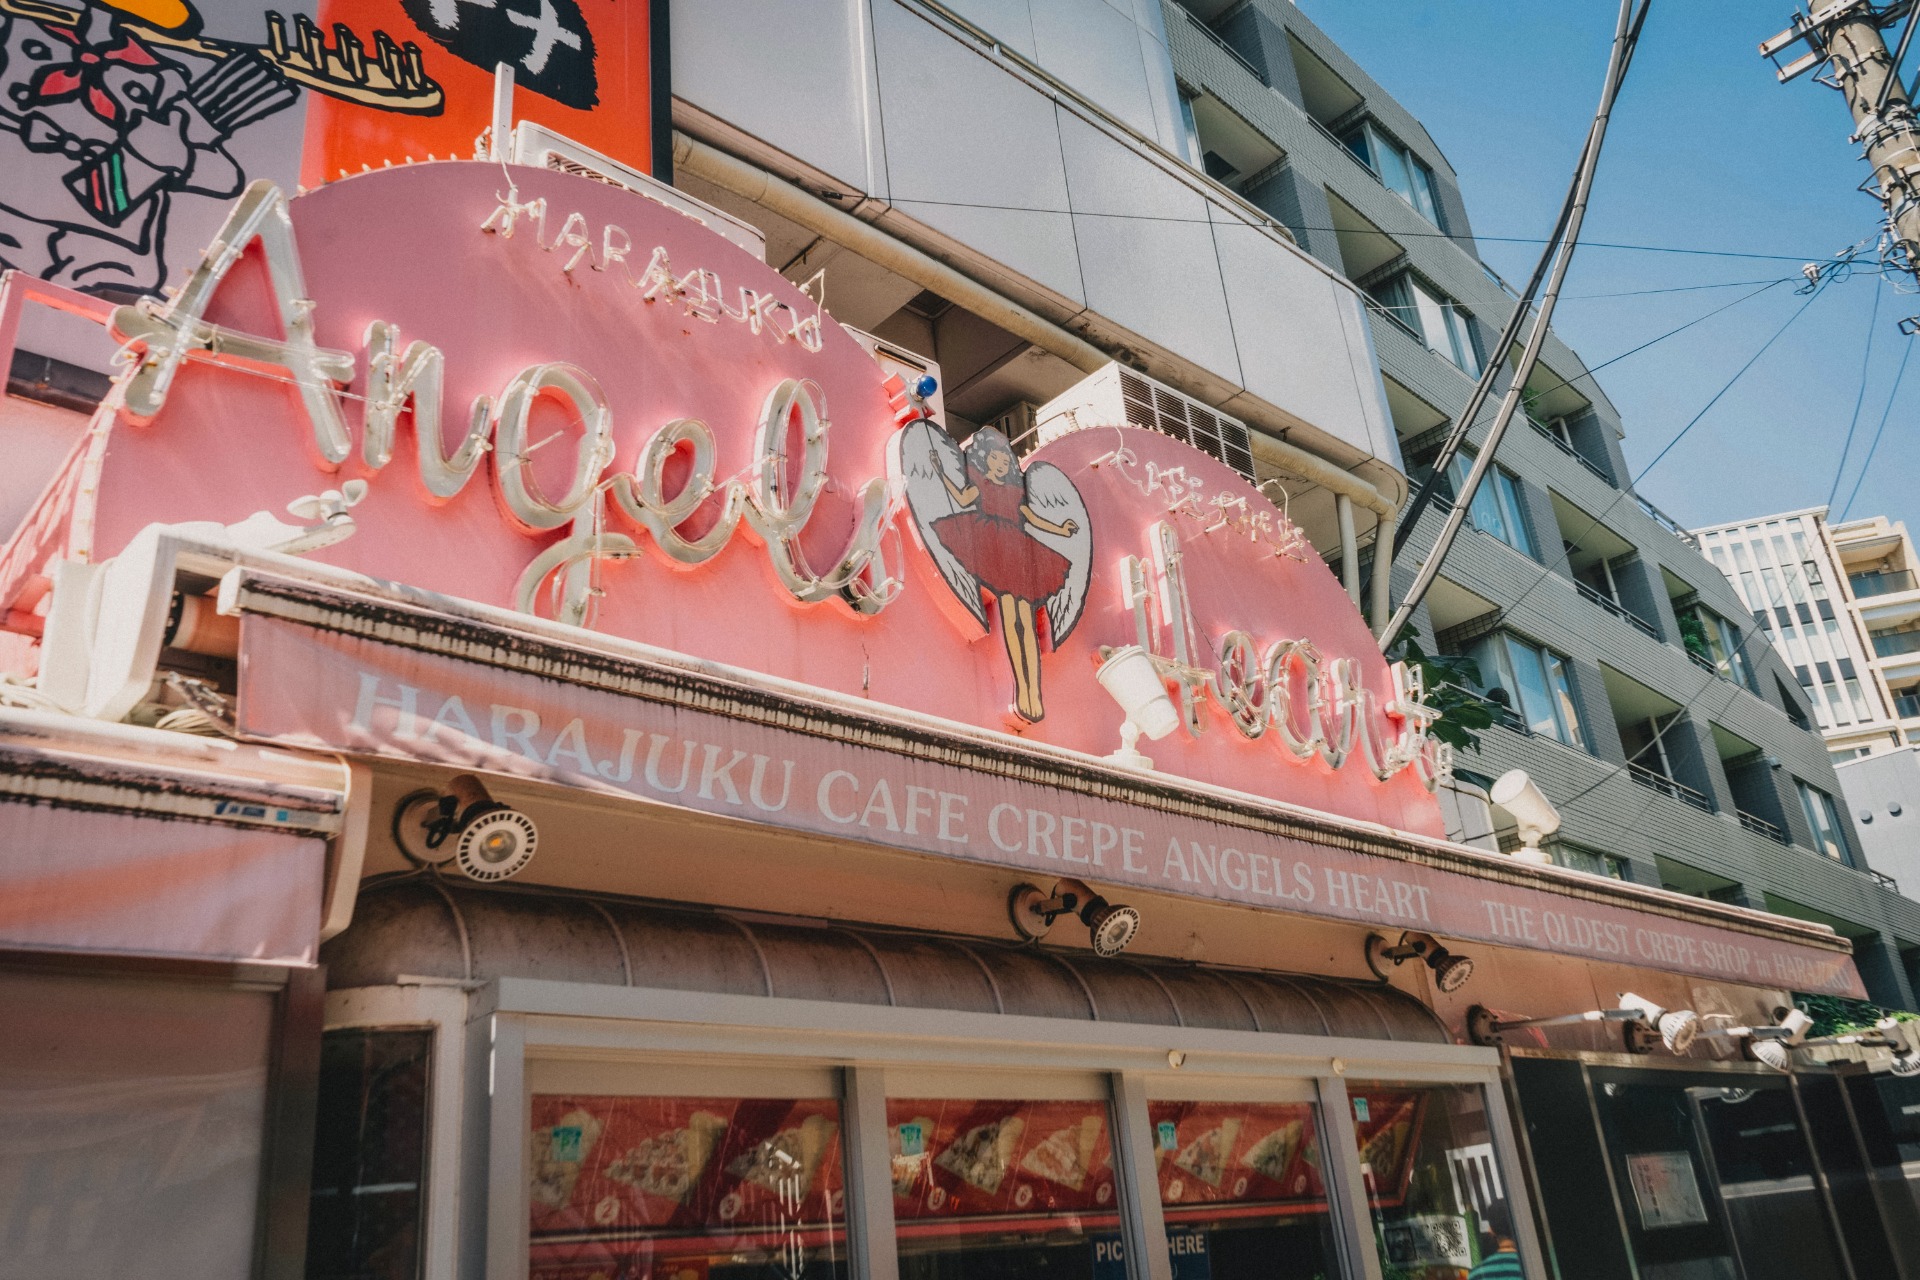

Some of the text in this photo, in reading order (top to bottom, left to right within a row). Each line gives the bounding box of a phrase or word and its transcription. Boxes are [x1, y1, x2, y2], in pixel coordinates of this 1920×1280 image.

[106, 177, 906, 627] Angels
[1119, 519, 1453, 795] Heart
[343, 671, 1432, 923] HARAJUKU CAFE CREPE ANGELS HEART
[1481, 898, 1539, 942] THE
[1542, 910, 1632, 957] OLDEST
[1634, 927, 1701, 968] CREPE
[1702, 939, 1751, 976] SHOP
[1752, 951, 1772, 979] in
[1096, 1234, 1206, 1262] PIC HERE
